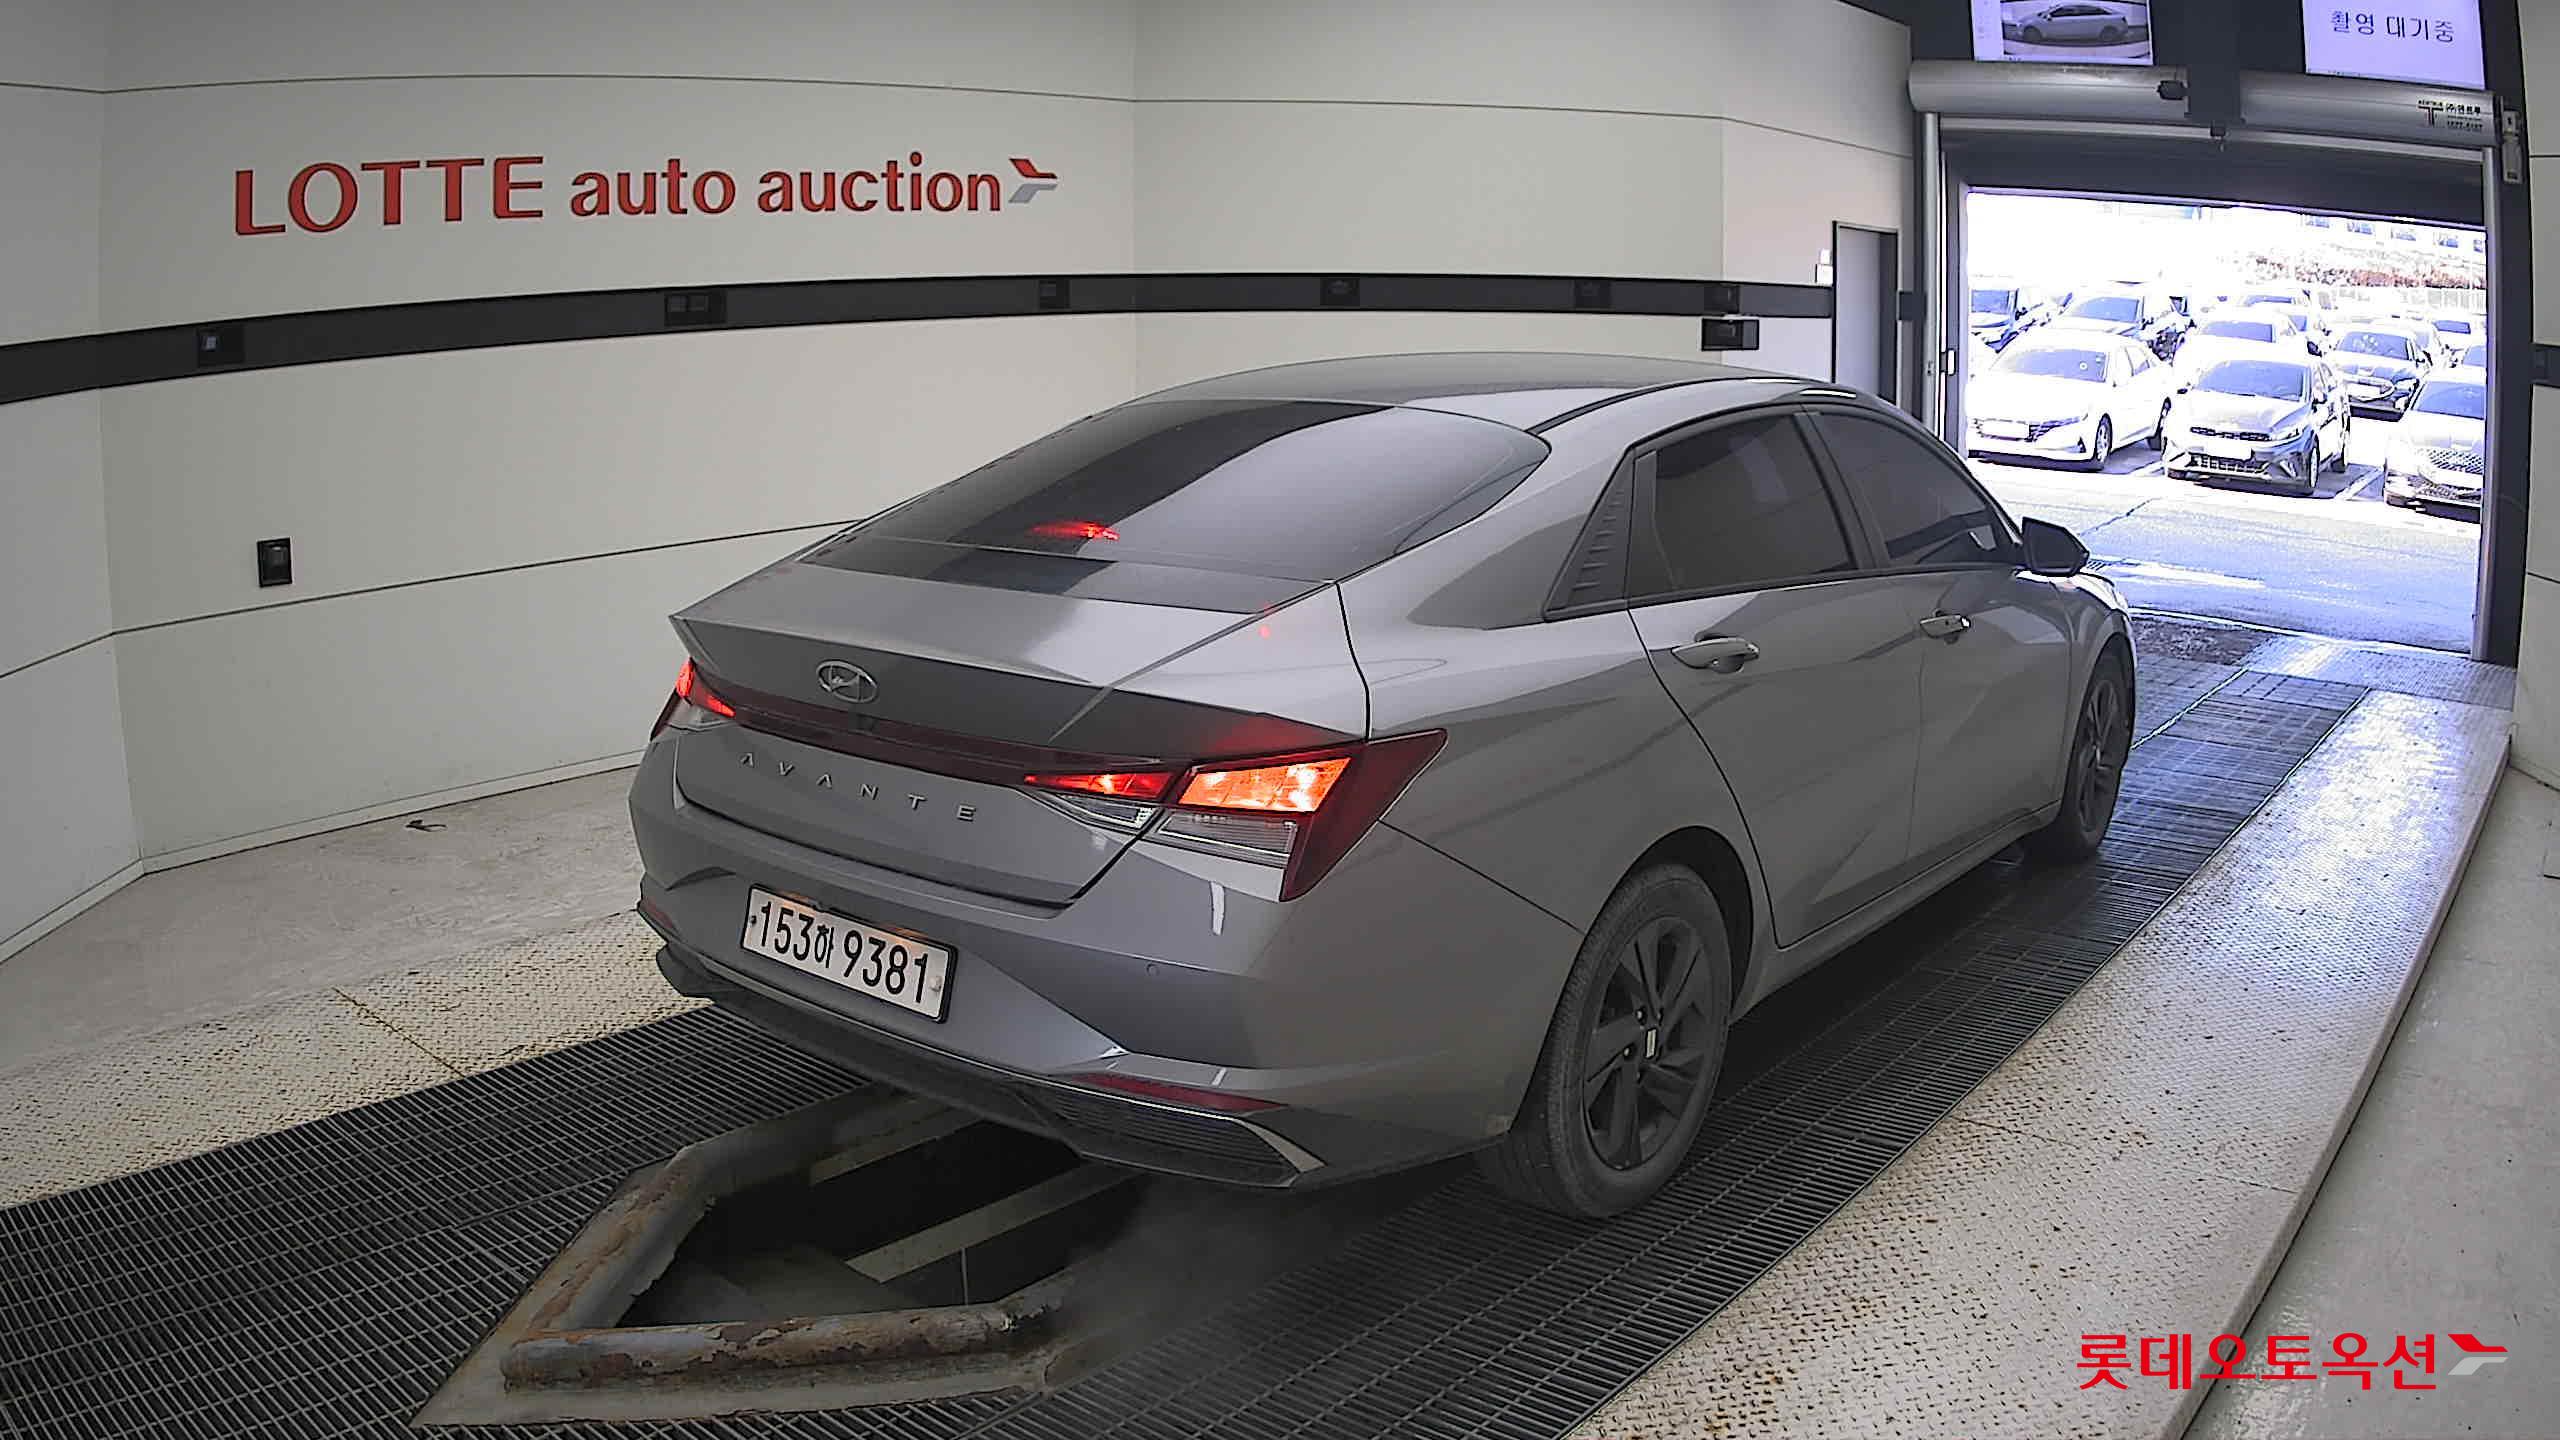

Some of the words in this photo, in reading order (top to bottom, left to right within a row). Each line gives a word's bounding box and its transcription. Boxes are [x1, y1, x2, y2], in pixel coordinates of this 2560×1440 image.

[2385, 15, 2455, 43] 대기중
[235, 156, 542, 236] LOTTE
[570, 158, 737, 217] auto
[757, 152, 1001, 215] auction
[739, 752, 978, 822] AVANTE
